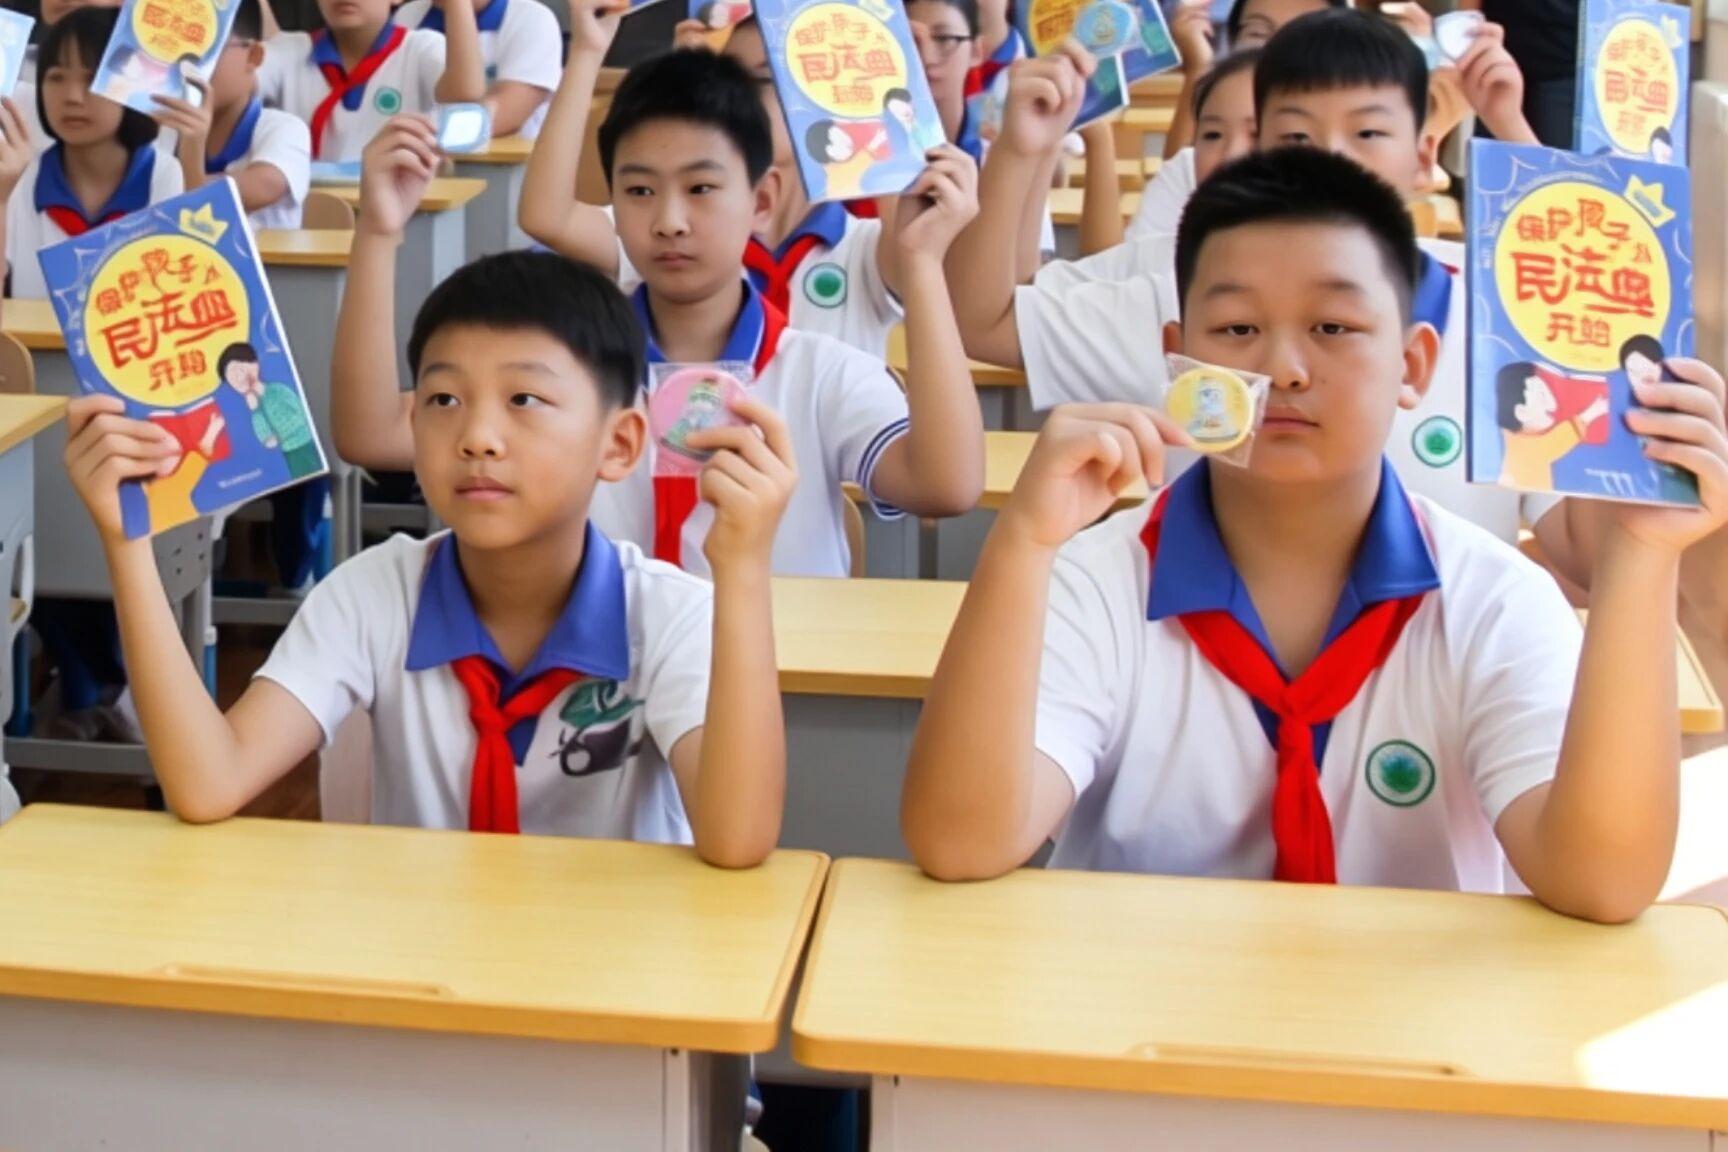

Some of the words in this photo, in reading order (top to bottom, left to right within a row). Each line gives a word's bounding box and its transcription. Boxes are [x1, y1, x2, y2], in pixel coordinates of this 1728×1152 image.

[797, 42, 898, 83] 民法典
[1509, 243, 1656, 318] 民法典
[101, 288, 238, 369] 民法典
[1546, 311, 1611, 348] 开始
[148, 349, 208, 392] 开始
